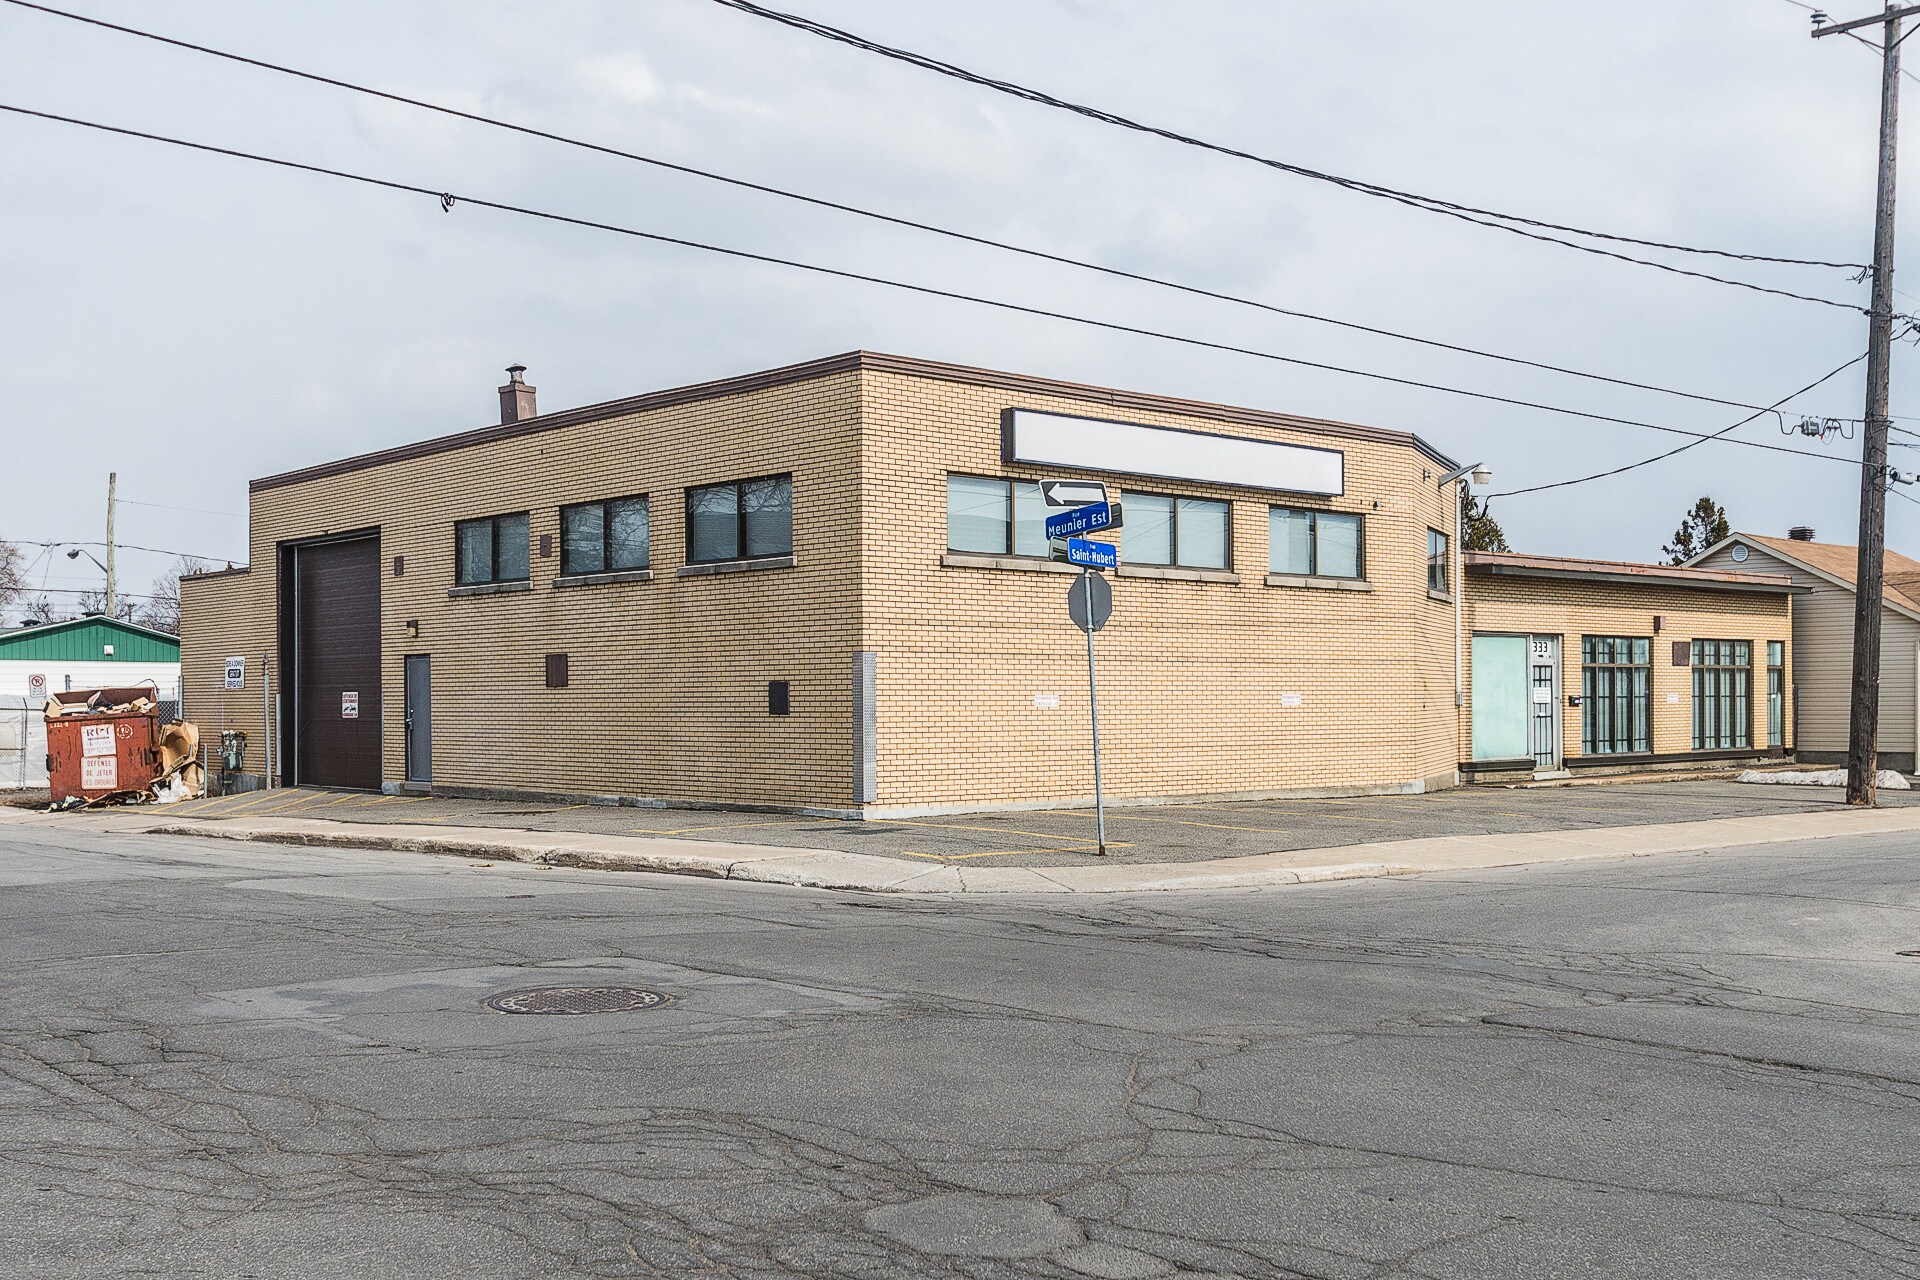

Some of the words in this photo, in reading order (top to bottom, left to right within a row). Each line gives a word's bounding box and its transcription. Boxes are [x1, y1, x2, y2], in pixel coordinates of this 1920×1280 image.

[1048, 518, 1087, 537] Meunier
[1091, 511, 1107, 526] Est
[1071, 548, 1115, 566] Saint-Hubert
[1532, 641, 1548, 653] 333
[86, 769, 93, 777] DE
[96, 769, 113, 777] JETER
